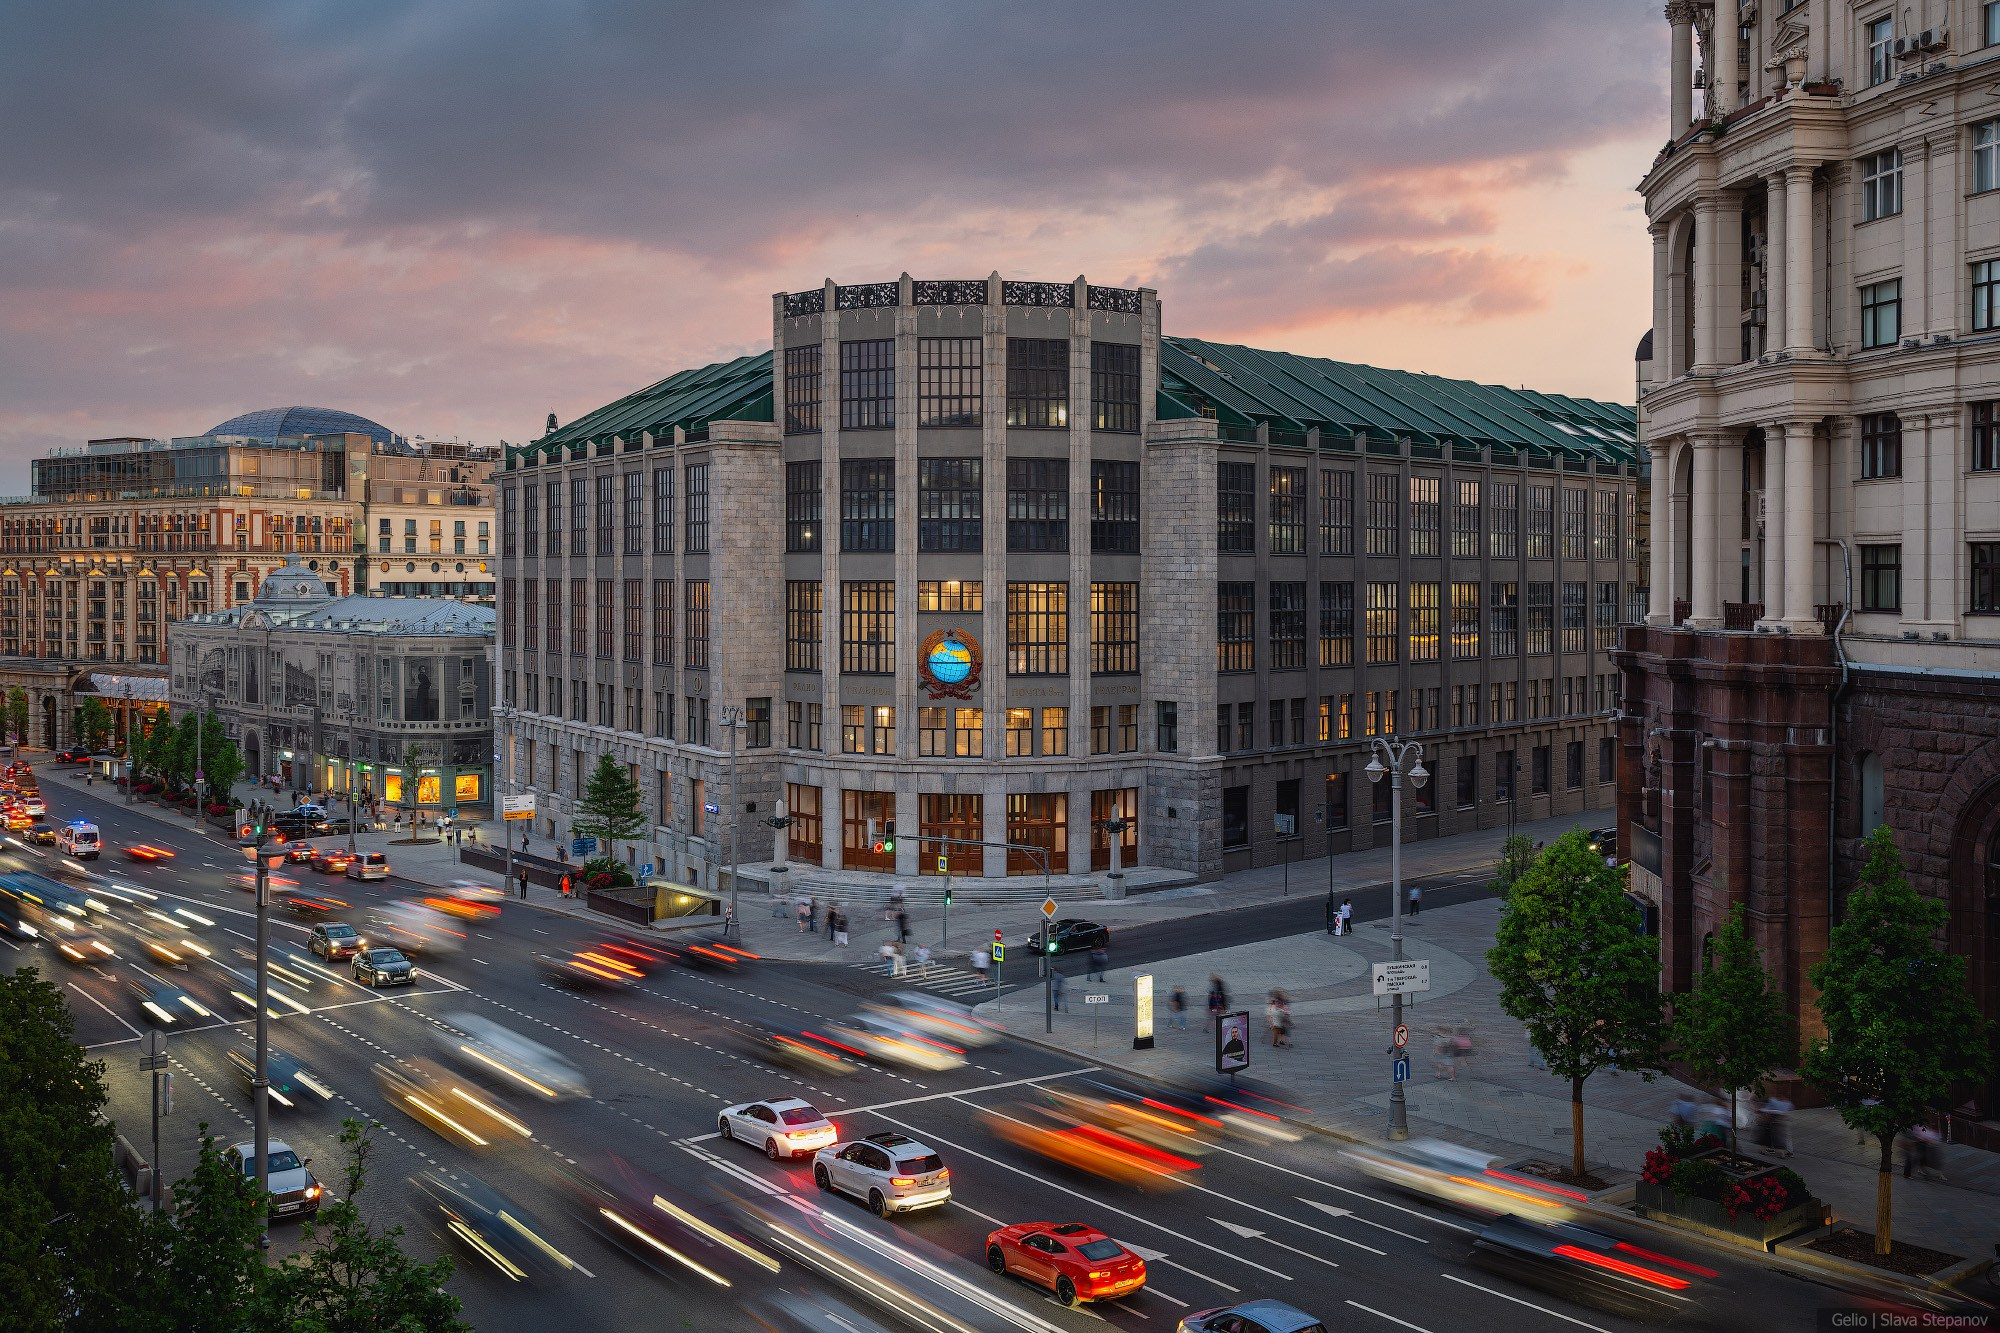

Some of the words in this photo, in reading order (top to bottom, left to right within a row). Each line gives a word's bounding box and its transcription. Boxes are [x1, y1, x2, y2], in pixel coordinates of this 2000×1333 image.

[793, 682, 816, 692] РАДИО
[845, 685, 891, 696] ТЕЛЕФОН
[1011, 687, 1046, 697] ПОЧТА
[1093, 685, 1138, 696] ТЕЛЕГРАФ
